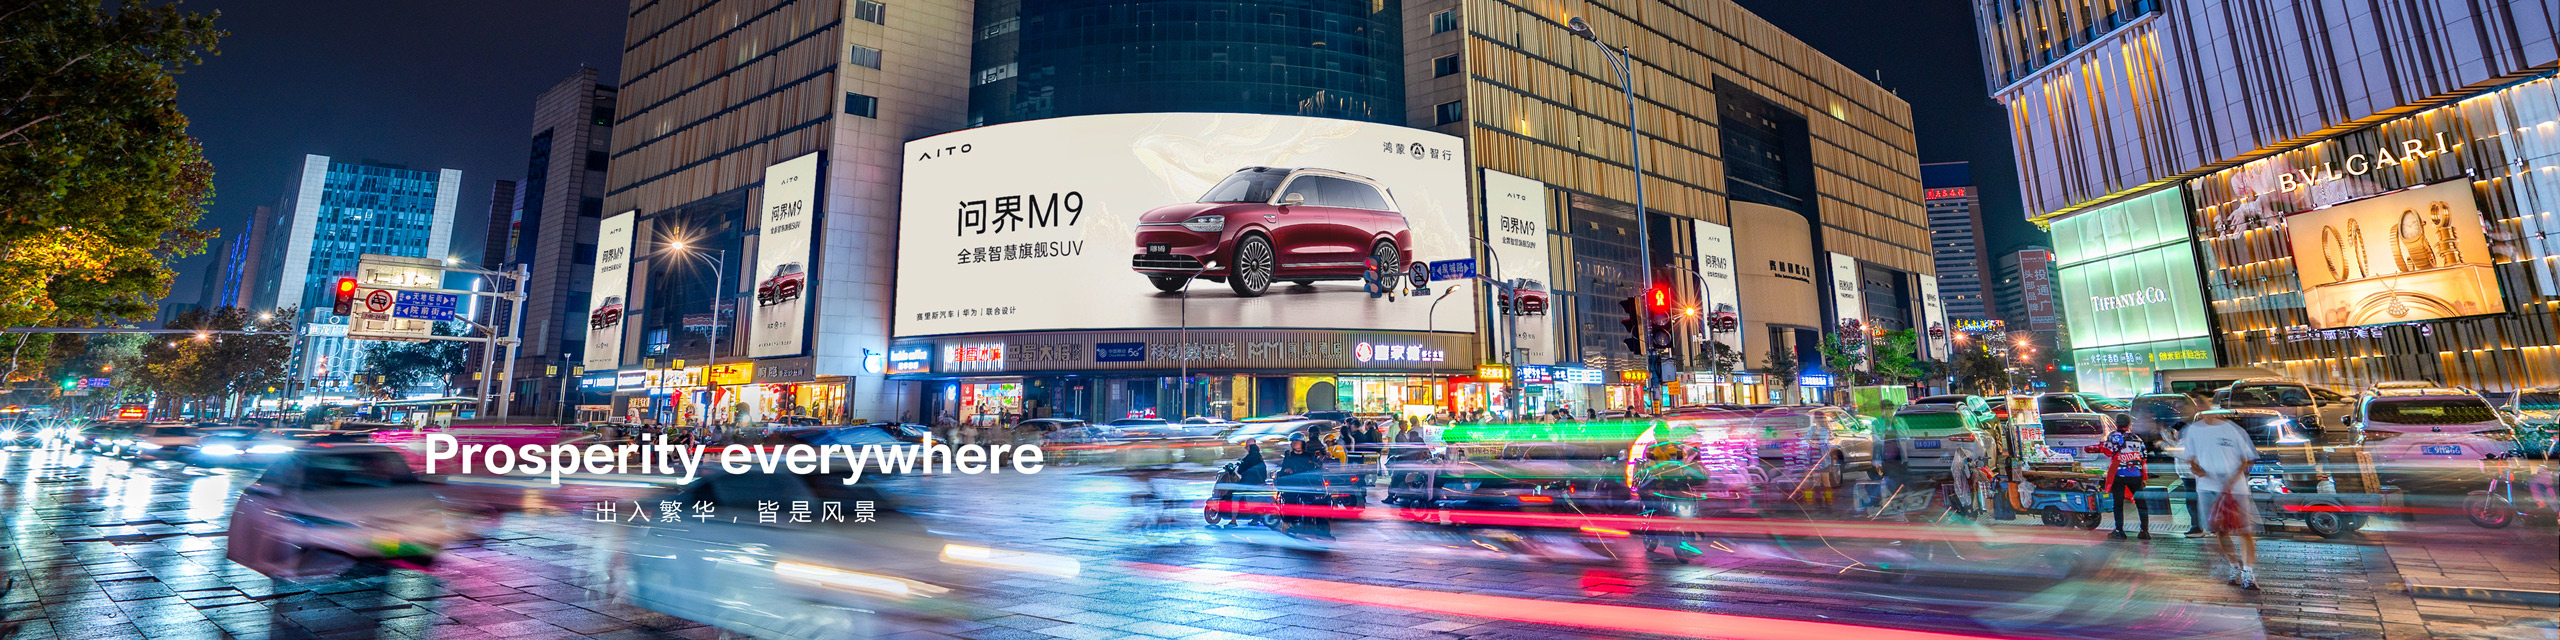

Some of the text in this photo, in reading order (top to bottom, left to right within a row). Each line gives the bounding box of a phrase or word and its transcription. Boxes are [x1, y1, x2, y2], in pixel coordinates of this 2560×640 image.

[918, 143, 973, 161] AITO
[1382, 141, 1452, 161] 鸿蒙 智行
[2278, 132, 2449, 194] BVLGARI
[780, 175, 799, 186] AITO
[1506, 193, 1527, 201] AITO
[770, 200, 803, 223] 问界M9
[957, 191, 1084, 237] 问界M9
[1500, 215, 1536, 236] 问界M9
[957, 240, 1084, 265] 全景智慧旗舰SUV
[2024, 269, 2039, 312] 头部品牌
[2034, 269, 2052, 312] 投通广
[2090, 293, 2135, 312] TIFFANY
[2136, 290, 2147, 306] &
[410, 306, 440, 316] 院前街
[963, 308, 978, 317] 华为
[985, 306, 1016, 316] 联合设计
[955, 346, 1001, 362] 蜜雪冰城
[1007, 344, 1070, 361] 巴蜀大将
[1127, 347, 1140, 357] 5G
[1150, 342, 1237, 361] 移动数码城
